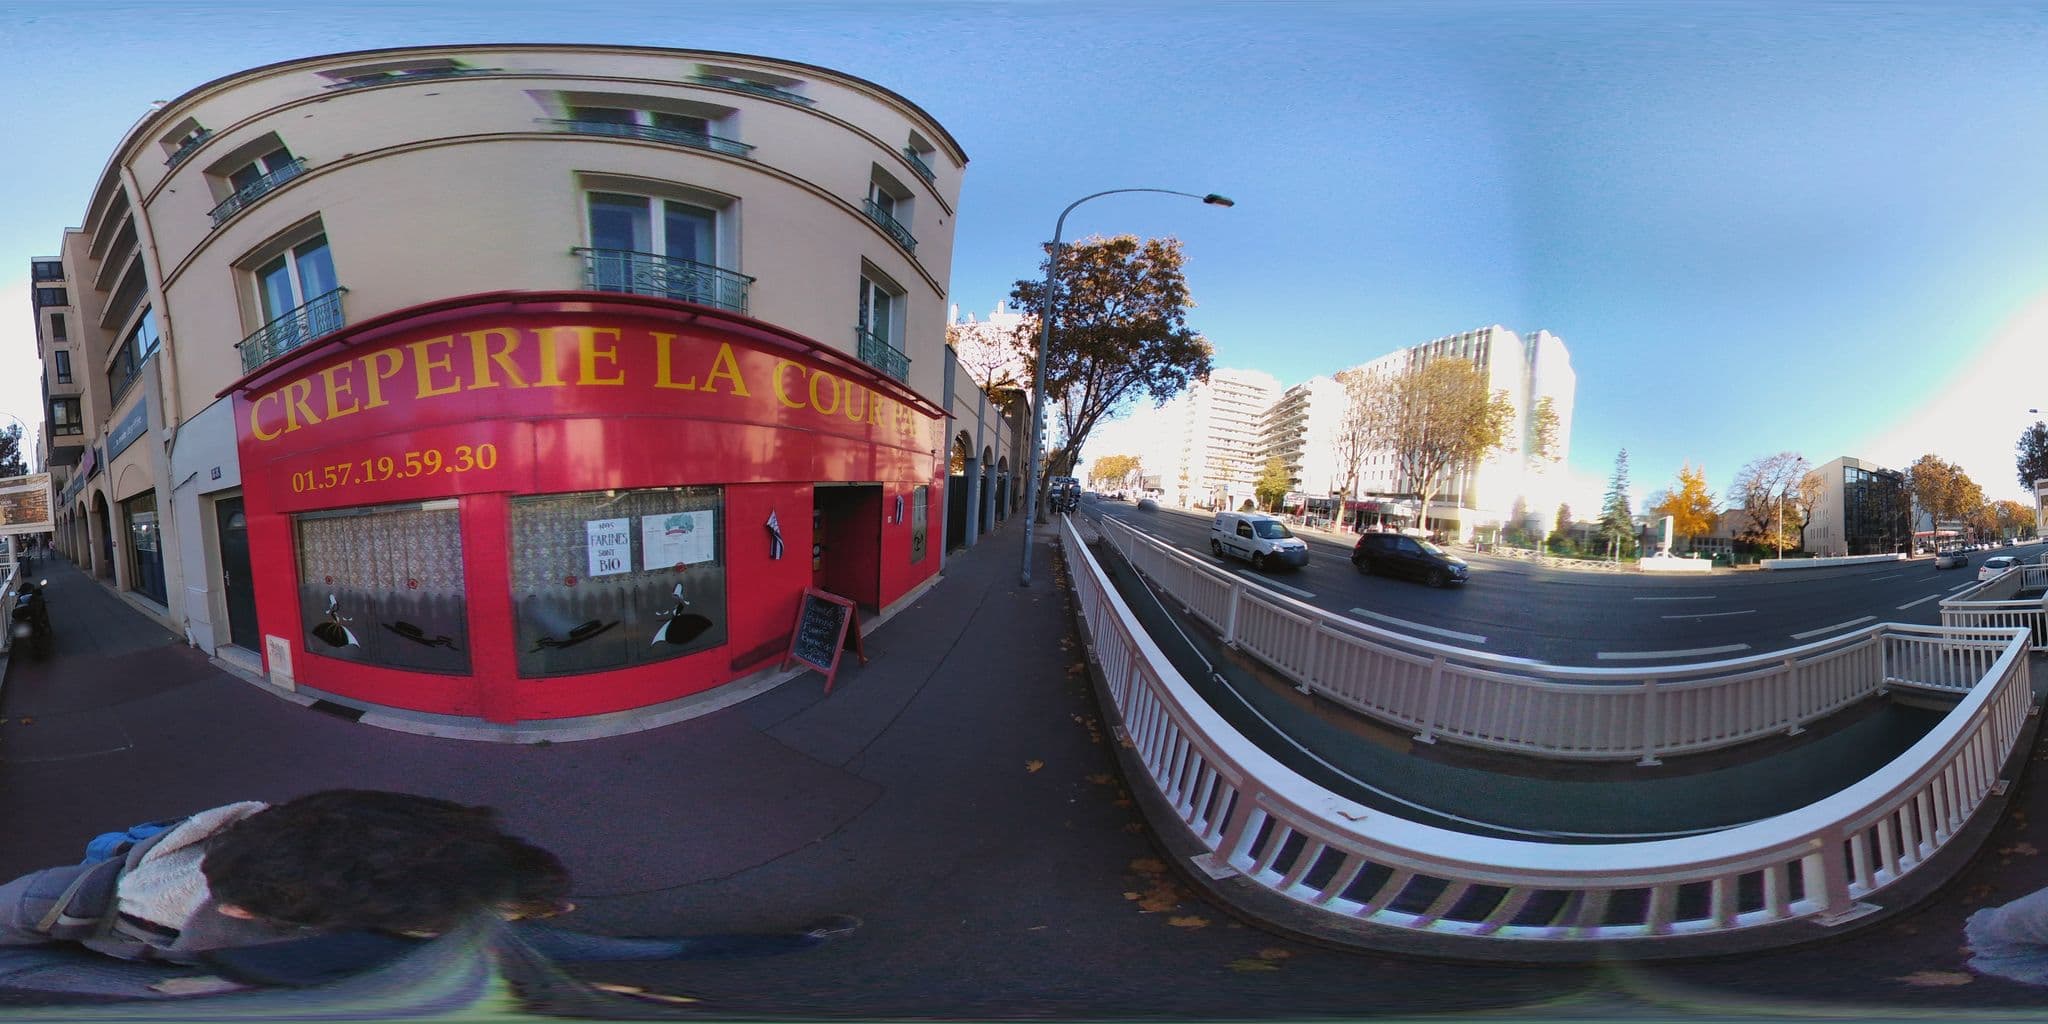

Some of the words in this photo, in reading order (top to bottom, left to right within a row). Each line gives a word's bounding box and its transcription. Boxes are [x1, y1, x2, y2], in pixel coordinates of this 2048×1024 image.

[250, 325, 625, 442] CREPERIE
[649, 331, 751, 397] LA
[772, 360, 886, 429] COUR
[291, 443, 498, 494] 01.57.19.59.30
[591, 532, 628, 547] FARINES
[599, 558, 621, 572] BIO
